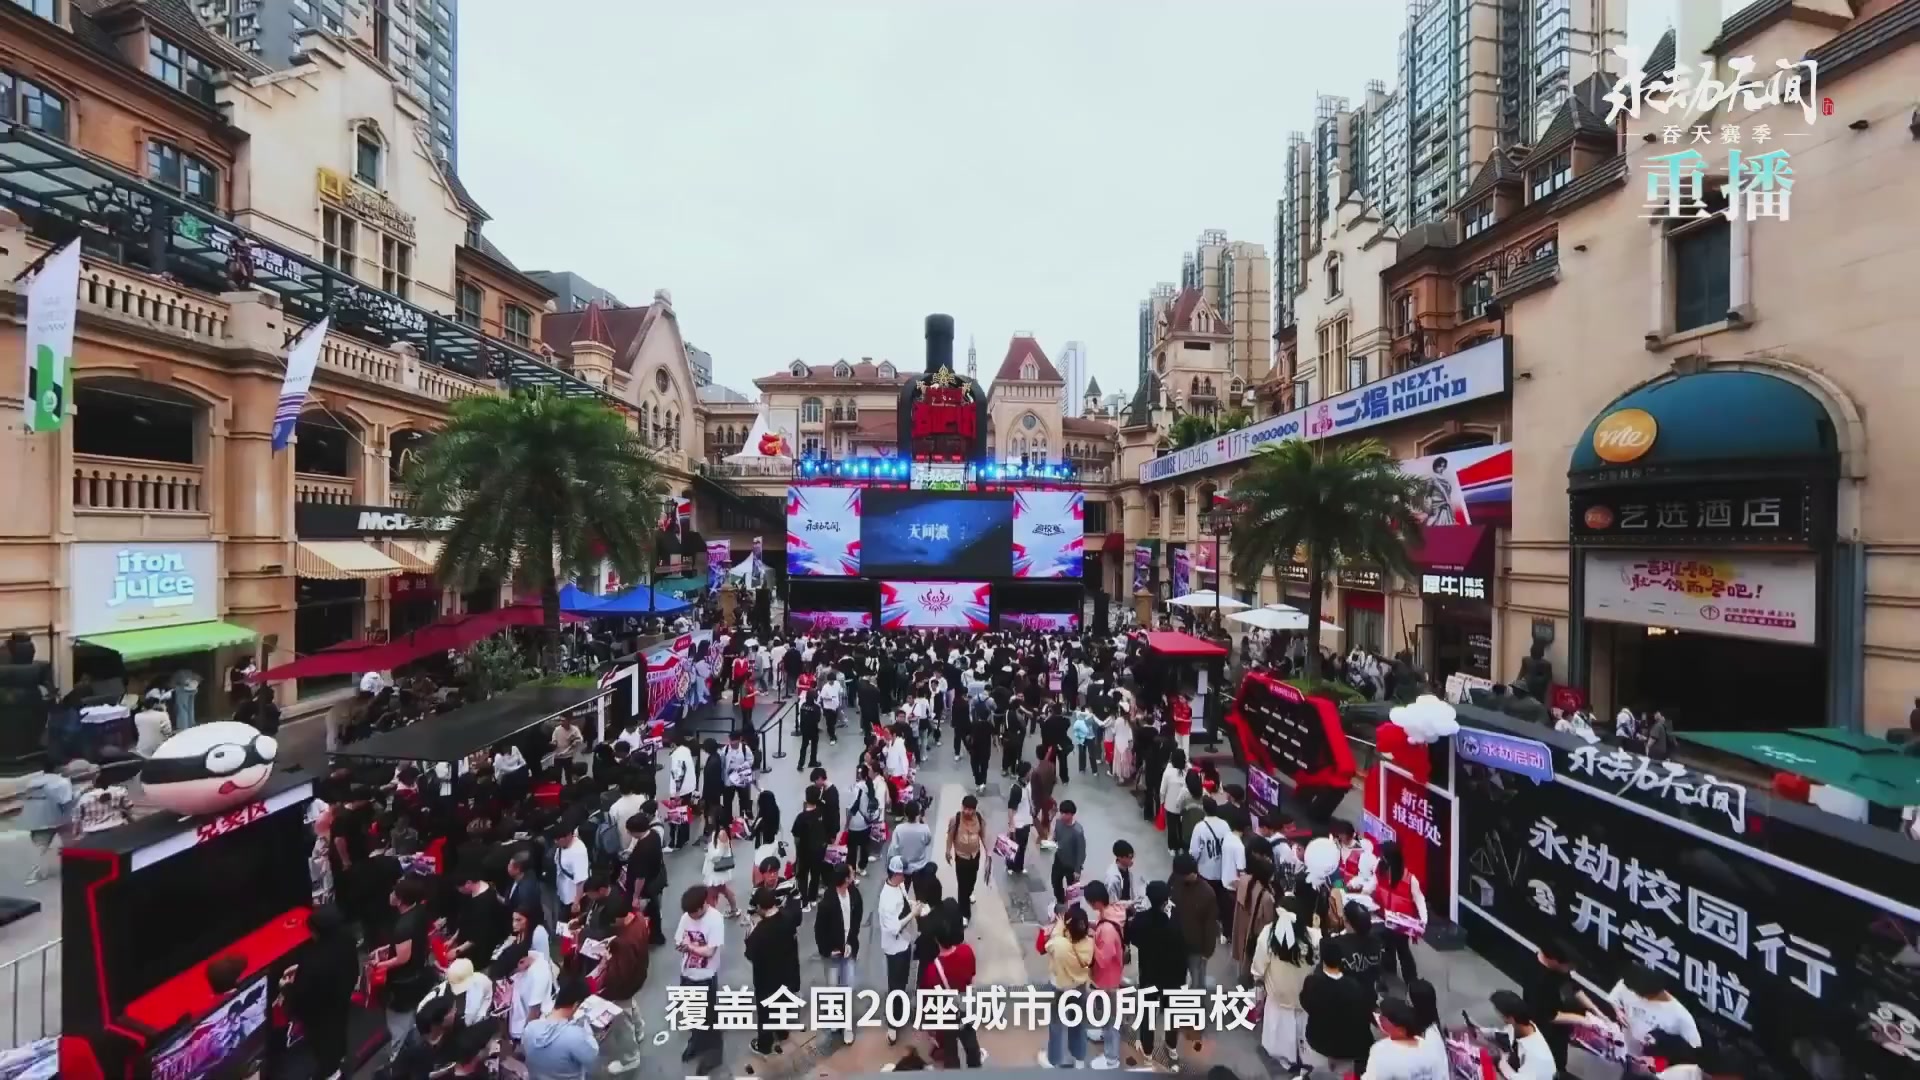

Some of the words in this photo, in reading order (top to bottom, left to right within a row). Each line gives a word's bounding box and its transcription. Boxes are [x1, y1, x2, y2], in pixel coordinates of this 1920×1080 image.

[1393, 377, 1467, 413] ROUND
[1182, 445, 1209, 471] 2046
[1619, 498, 1781, 529] 艺选酒店
[1400, 787, 1434, 821] 新生
[1392, 802, 1442, 847] 报到处
[1528, 815, 1838, 999] 永劫校园行
[1569, 891, 1753, 1030] 开学啦
